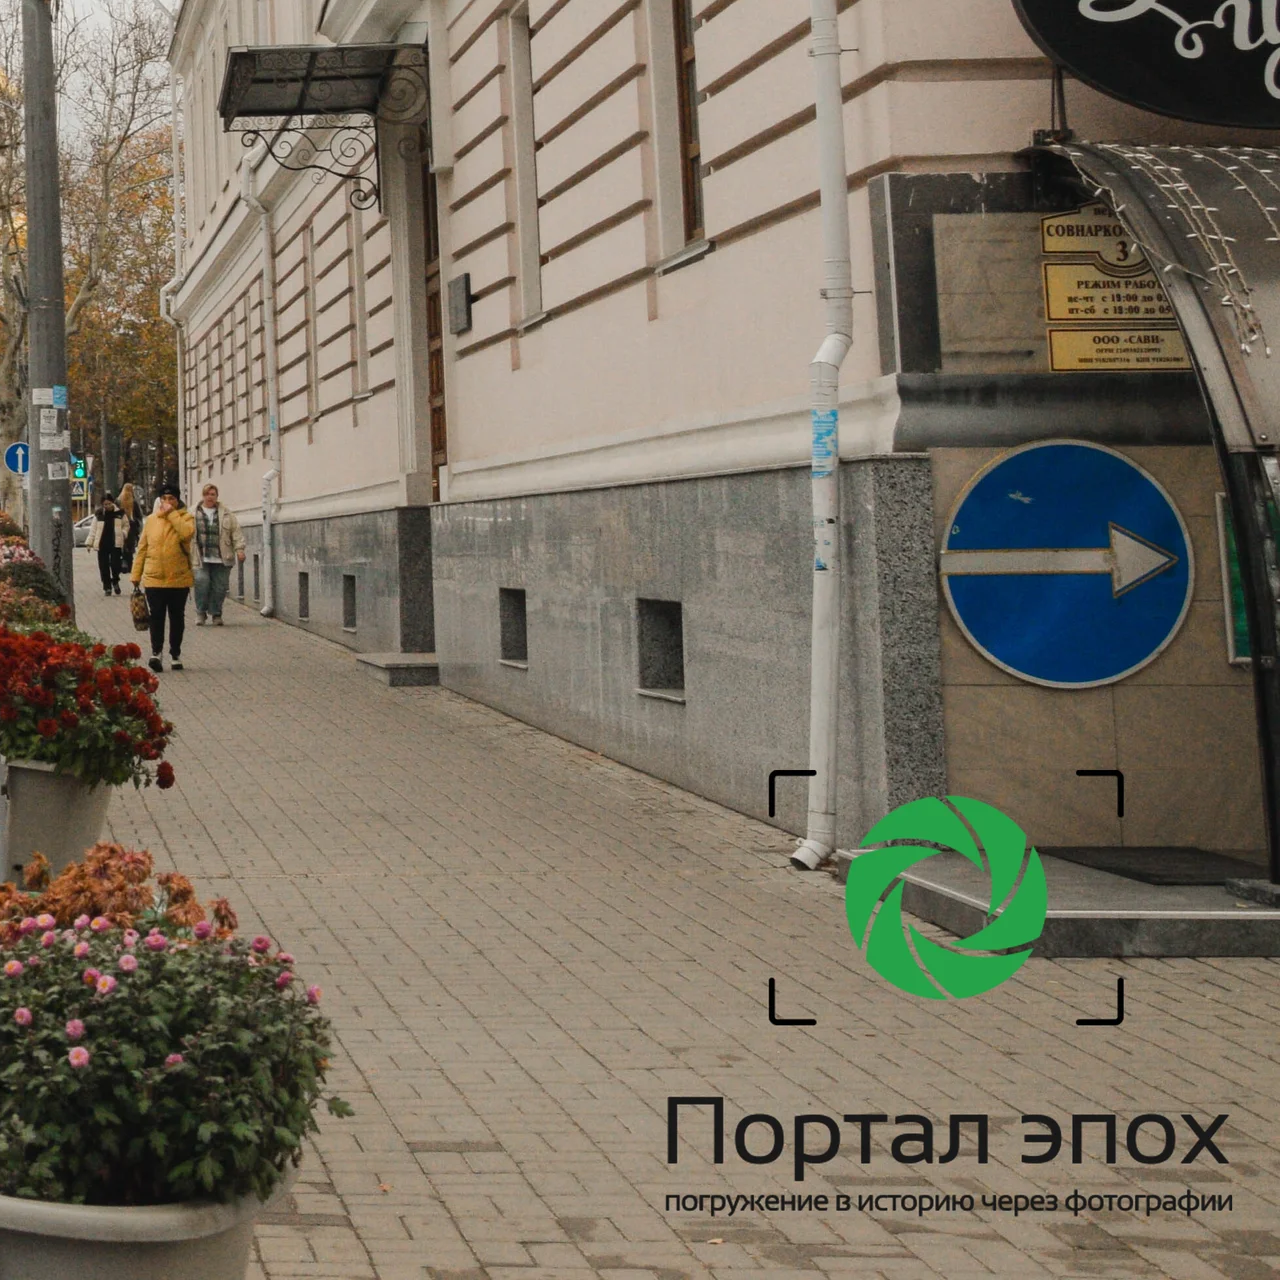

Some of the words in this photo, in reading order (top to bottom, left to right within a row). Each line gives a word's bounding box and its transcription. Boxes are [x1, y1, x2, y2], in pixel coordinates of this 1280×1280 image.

[1046, 224, 1129, 237] СОВНАРКО
[1116, 240, 1129, 261] 3
[1076, 280, 1121, 289] РЕЖИМ
[1092, 335, 1120, 344] ООО
